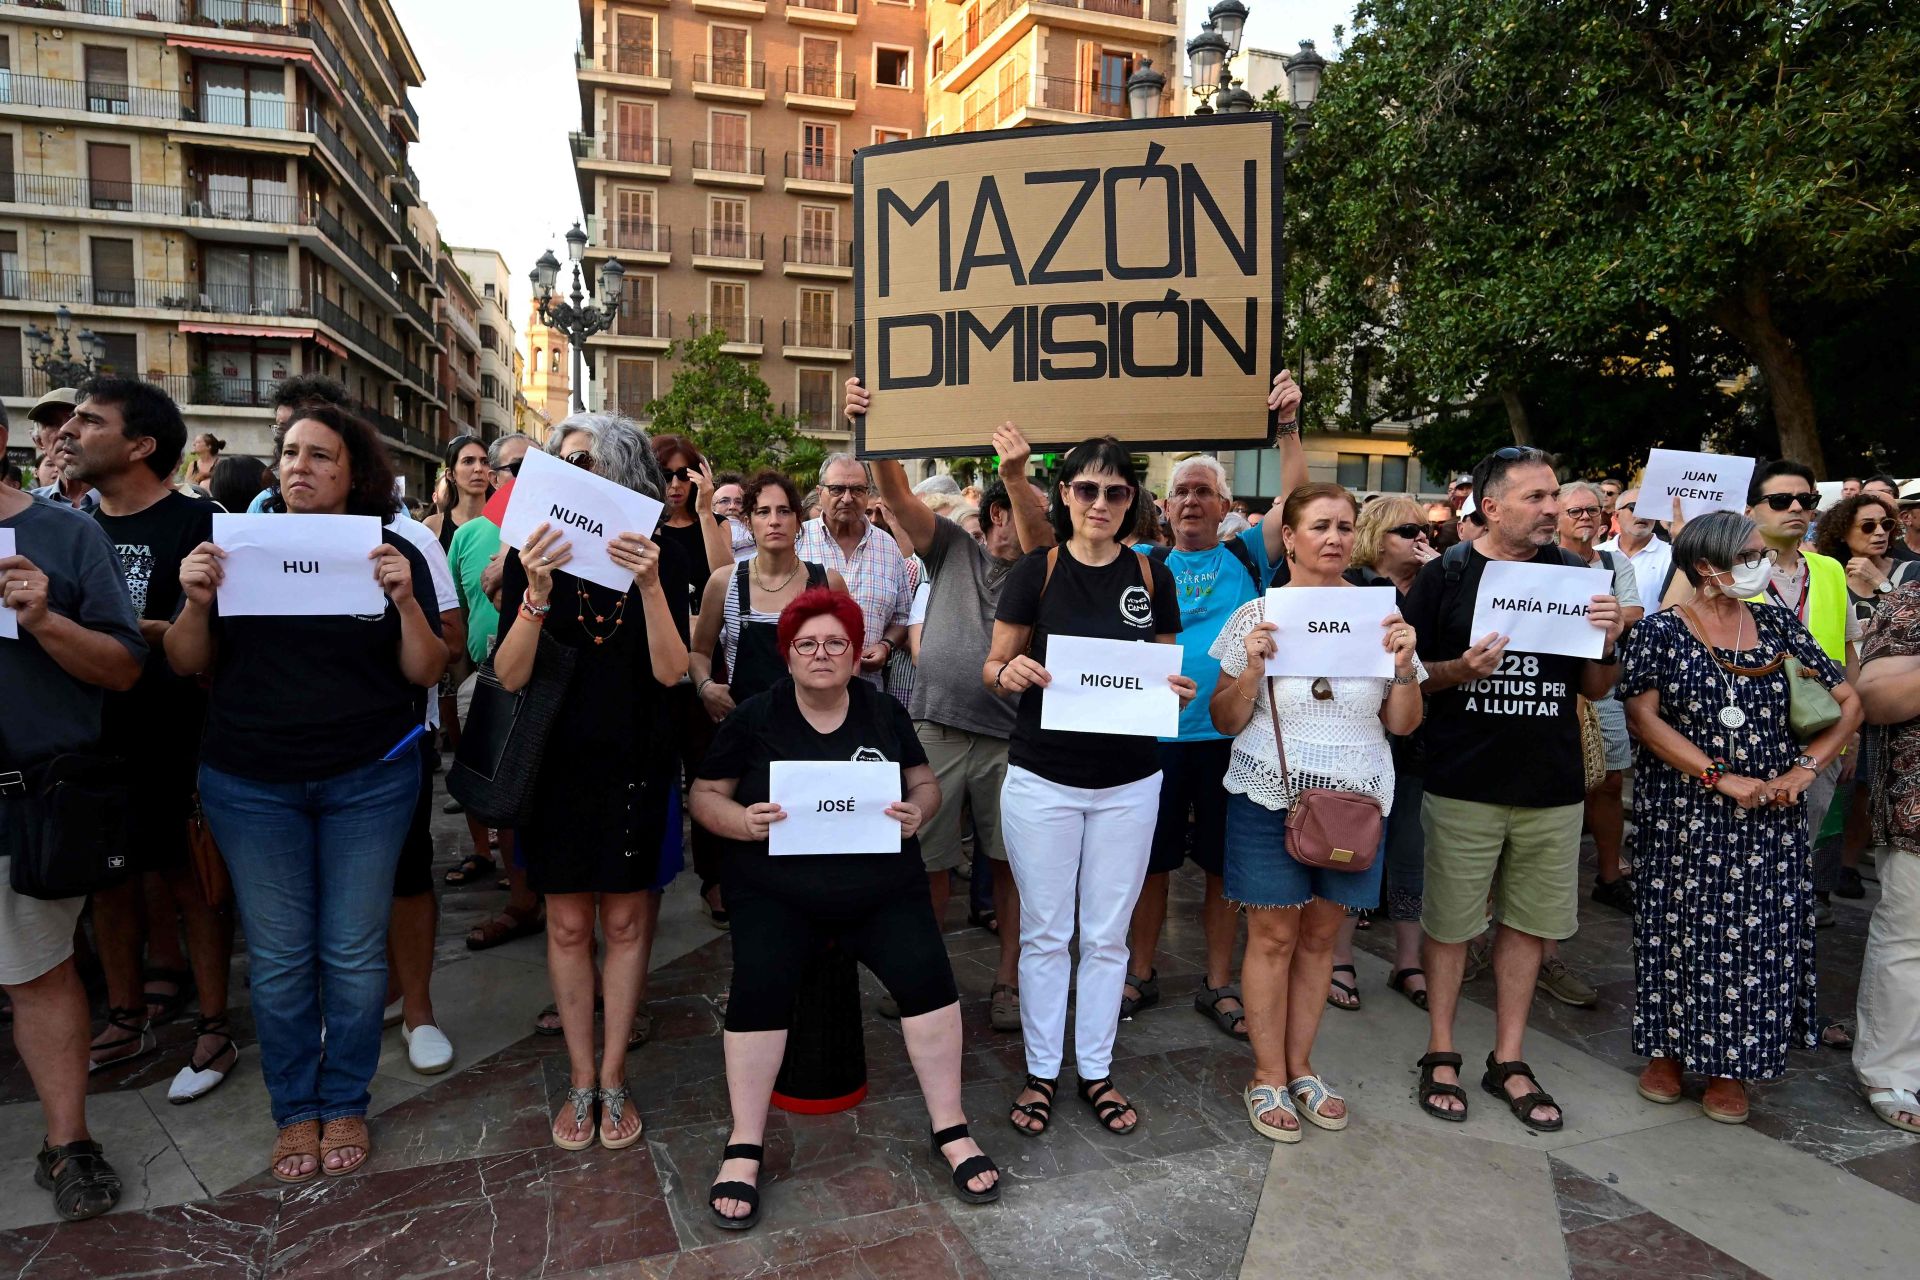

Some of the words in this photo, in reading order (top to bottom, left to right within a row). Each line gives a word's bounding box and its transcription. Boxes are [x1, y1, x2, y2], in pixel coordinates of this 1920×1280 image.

[877, 141, 1258, 298] MAZÓN
[878, 288, 1258, 391] DIMISIÓN
[1681, 470, 1718, 483] JUAN
[1667, 486, 1724, 502] VICENTE
[549, 503, 603, 538] NURIA
[283, 560, 319, 574] HUI
[1491, 597, 1543, 613] MARÍA
[1546, 602, 1591, 617] PILAR
[1308, 621, 1351, 634] SARA
[1080, 673, 1144, 690] MIGUEL
[1457, 680, 1537, 697] MOTIUS
[1542, 682, 1566, 697] PER
[1465, 697, 1478, 712] A
[1483, 698, 1560, 716] LLUITAR
[816, 796, 856, 813] JOSÉ
